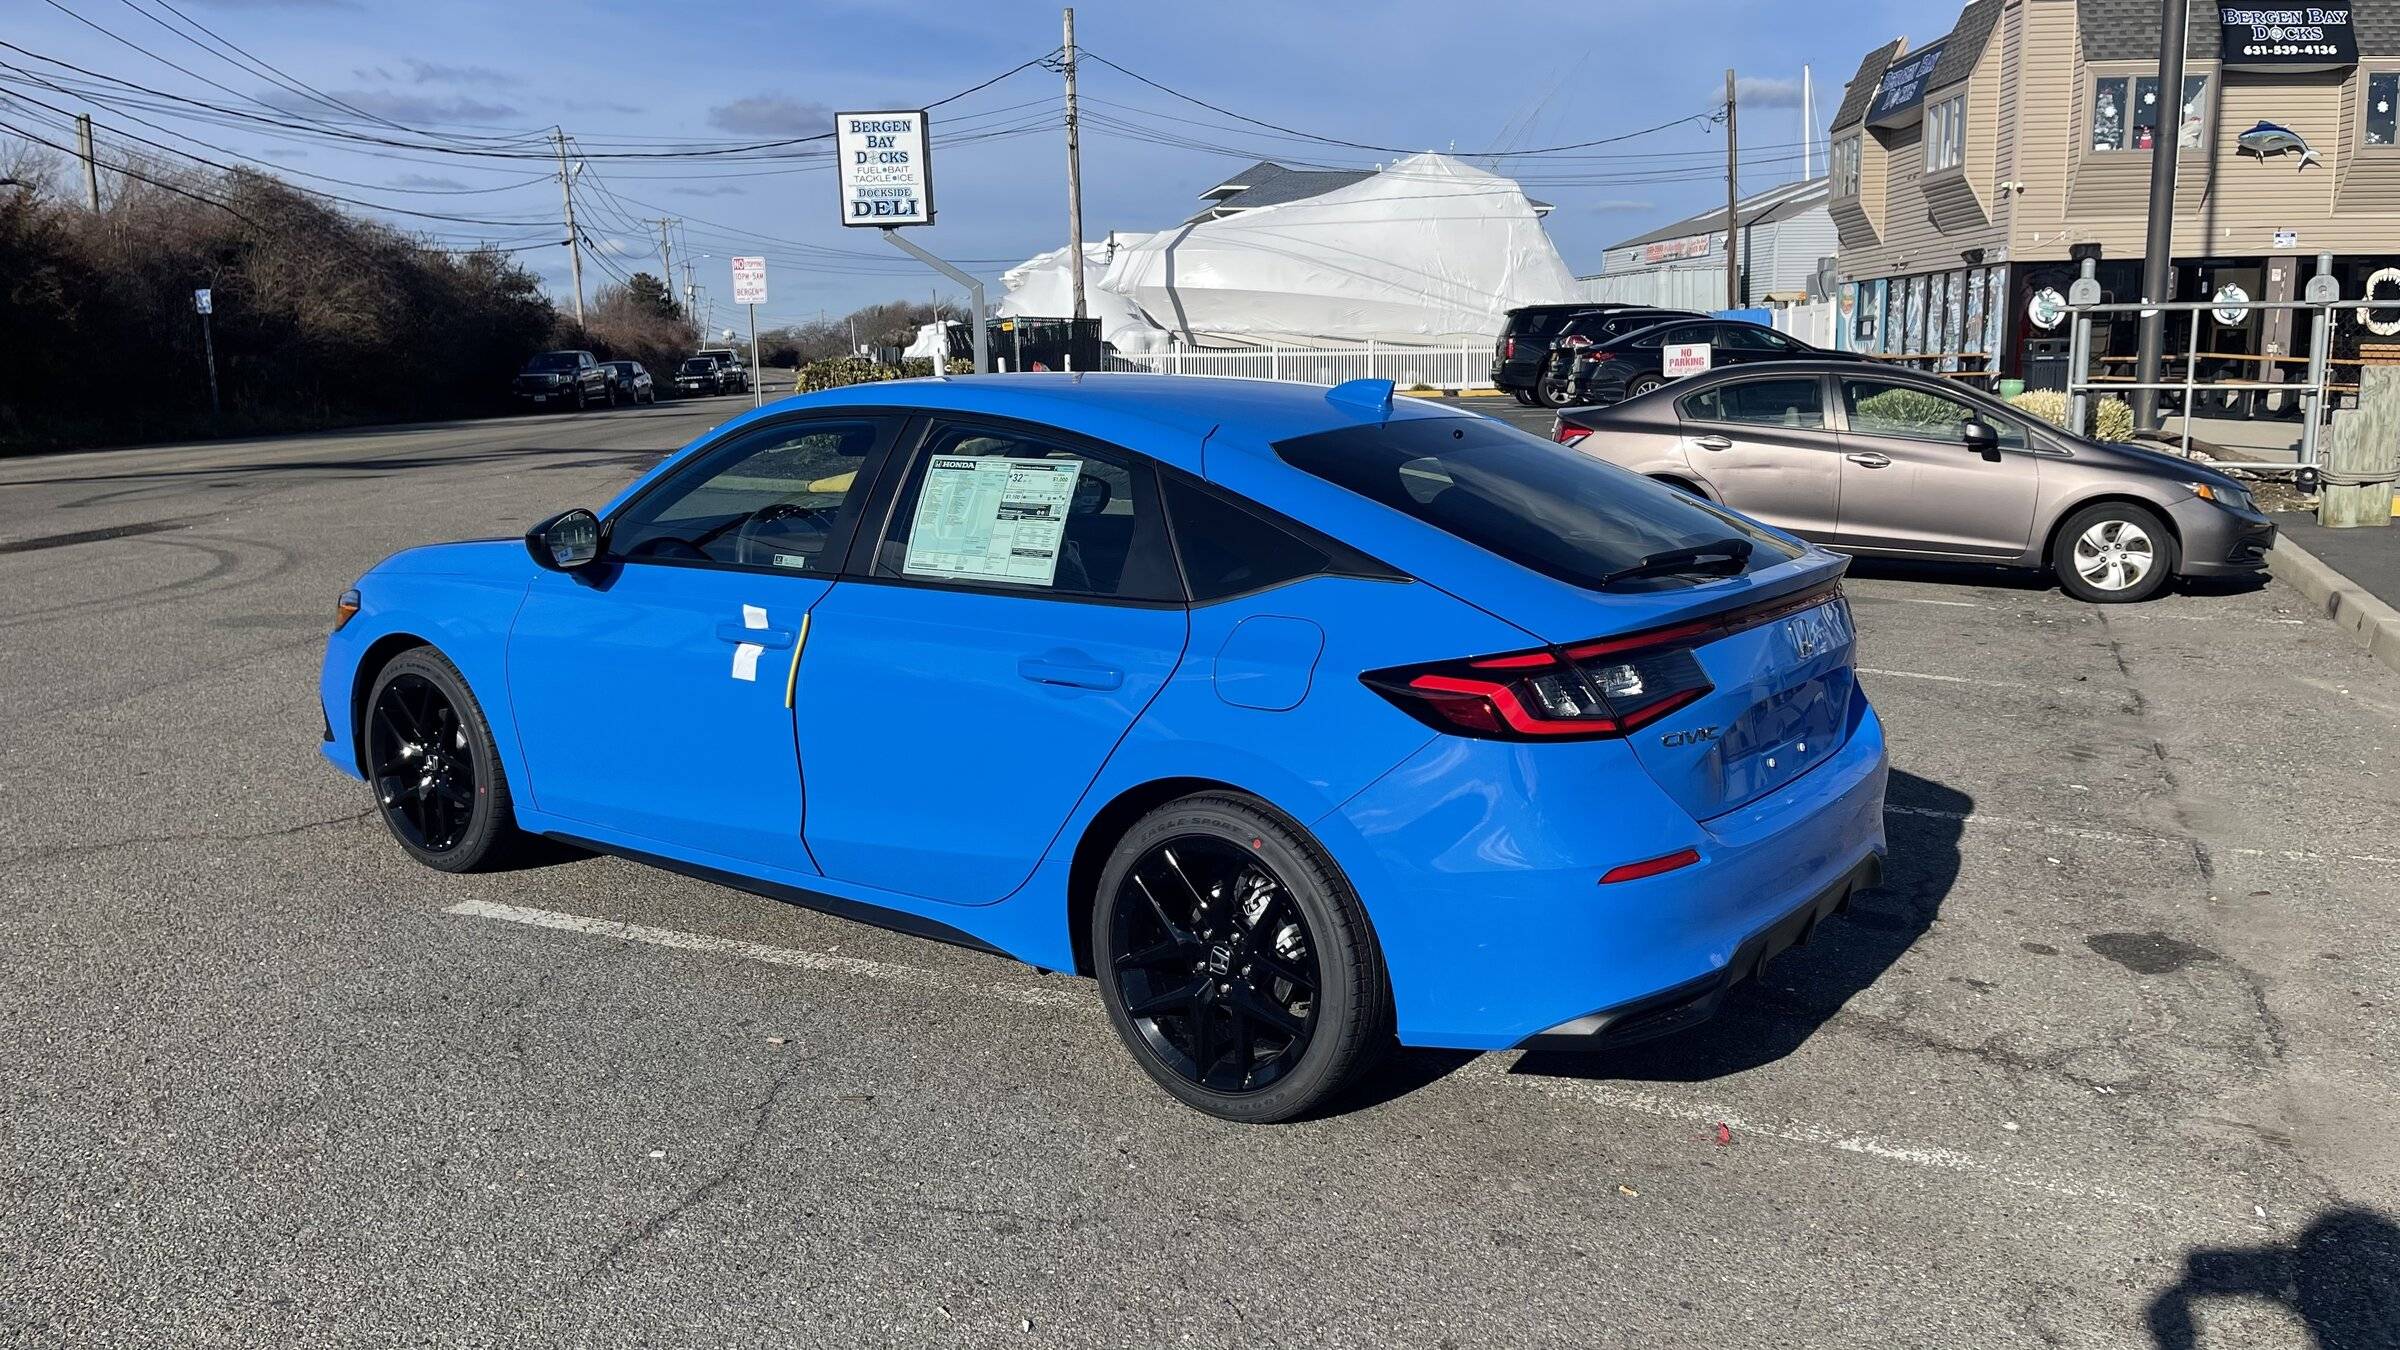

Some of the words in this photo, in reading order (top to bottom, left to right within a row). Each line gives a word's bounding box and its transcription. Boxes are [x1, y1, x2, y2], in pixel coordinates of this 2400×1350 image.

[2222, 8, 2302, 25] BERGEN
[2307, 8, 2348, 24] BAY
[2252, 25, 2324, 41] DOCKS
[2243, 45, 2337, 55] 631-539-4136
[850, 120, 912, 133] BERGEN
[867, 135, 896, 148] BAY
[856, 151, 909, 164] DOCKS
[854, 174, 891, 183] TACKLE
[897, 174, 913, 182] ICE
[858, 187, 912, 198] DOCKSIDE
[852, 200, 919, 217] DELI
[1680, 348, 1692, 357] NO
[1669, 357, 1705, 367] PARKING
[942, 461, 975, 470] HONDA
[1012, 473, 1024, 483] 32
[1661, 726, 1720, 748] CIVIC
